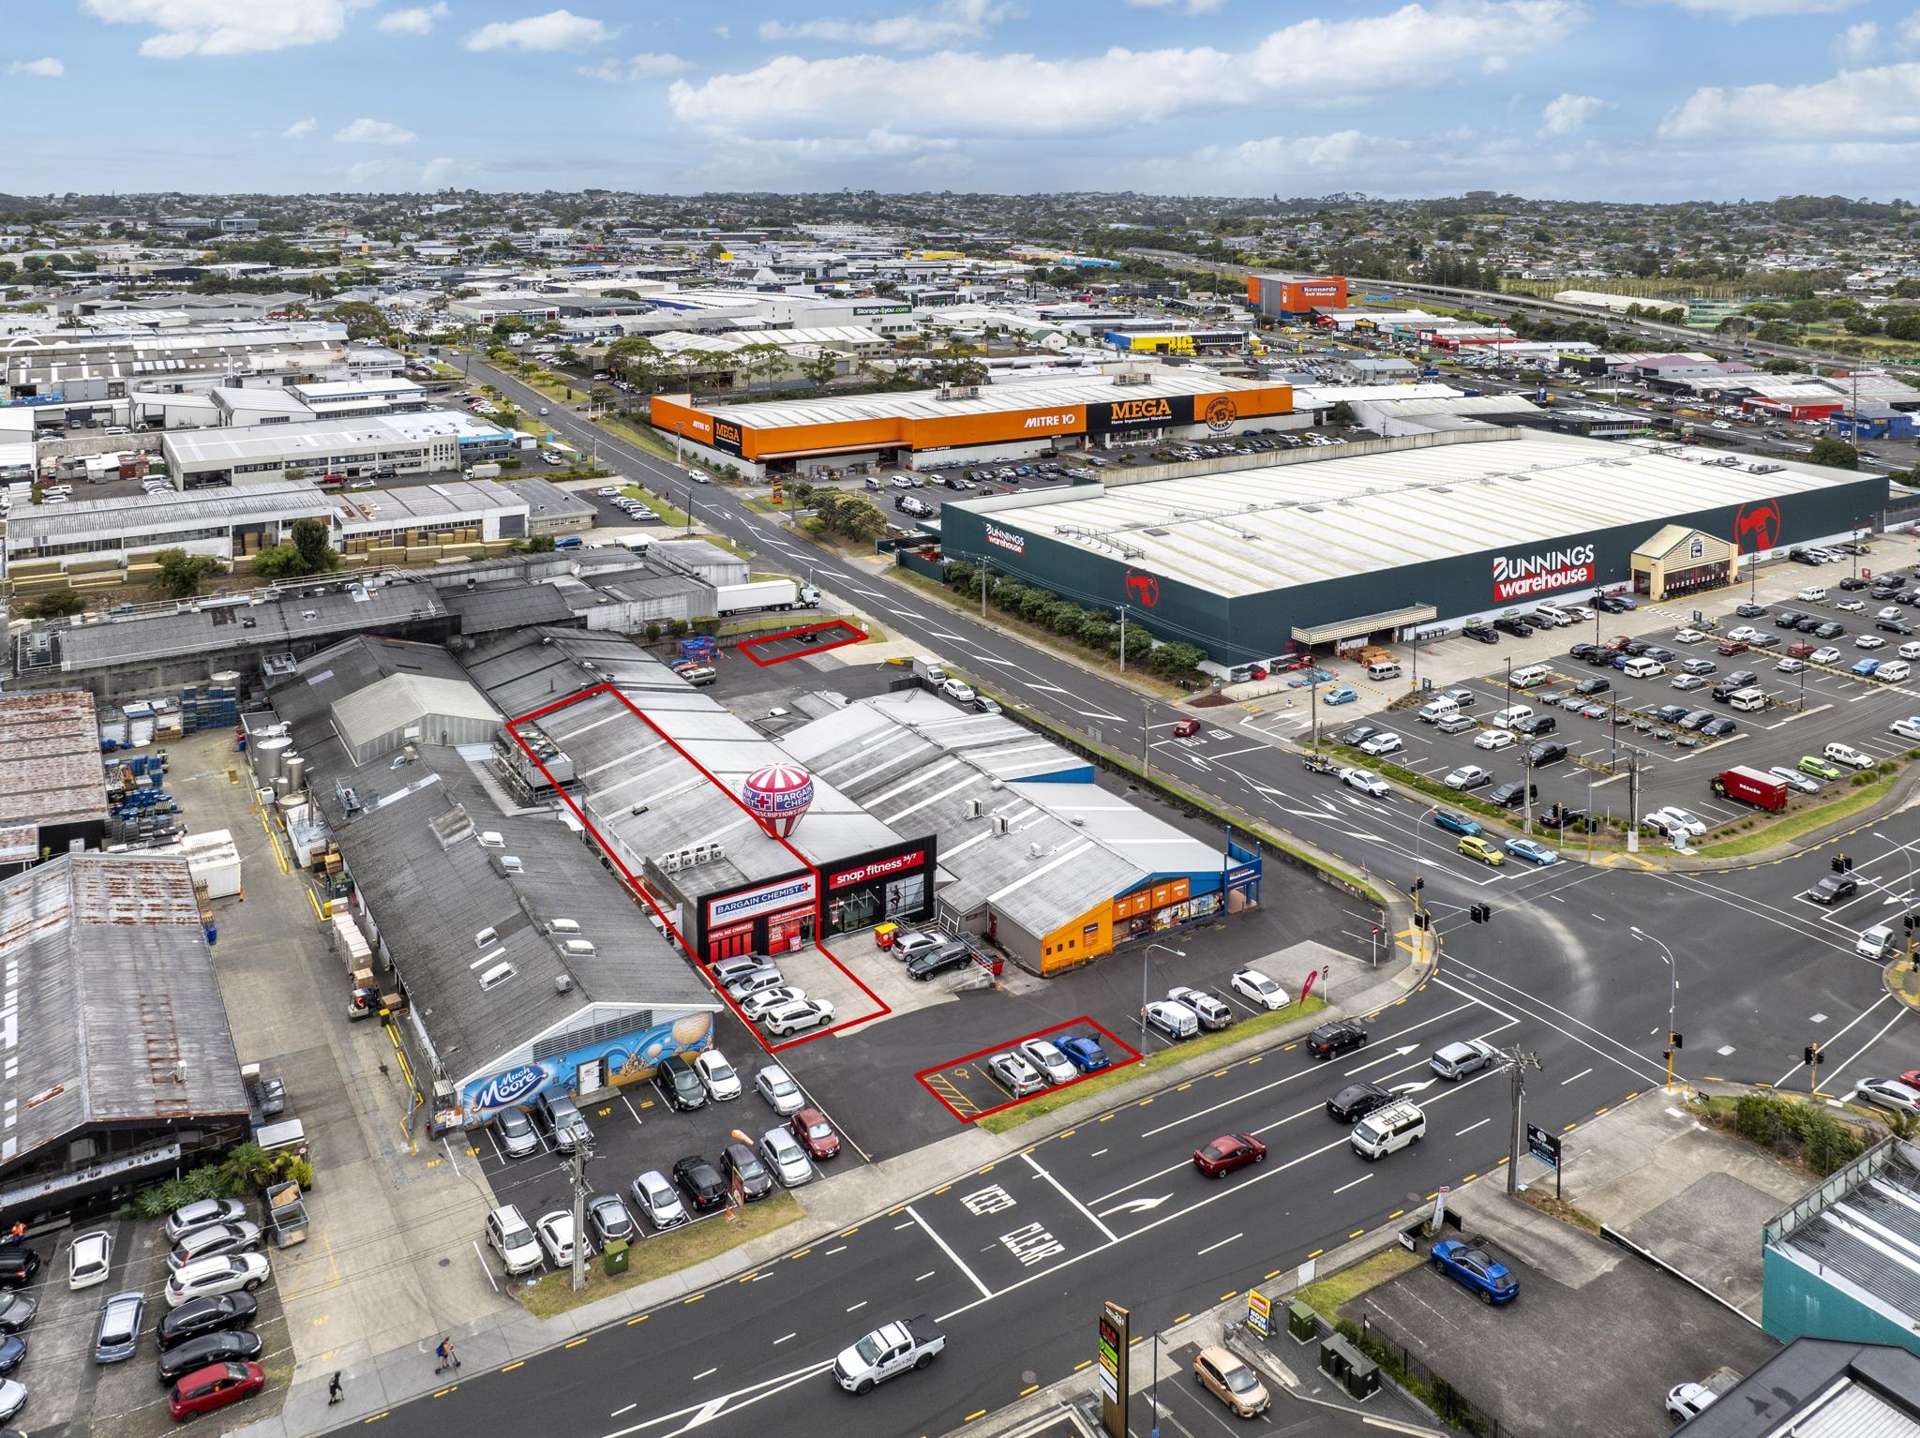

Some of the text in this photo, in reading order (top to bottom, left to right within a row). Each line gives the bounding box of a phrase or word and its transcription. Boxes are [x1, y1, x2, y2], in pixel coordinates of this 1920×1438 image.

[1024, 413, 1075, 428] MITRE 10
[1111, 399, 1172, 419] MEGA
[715, 422, 740, 442] MEGA
[985, 523, 1025, 546] BUNNINGS
[988, 535, 1022, 553] warehouse
[1492, 543, 1594, 582] BUNNINGS
[1499, 567, 1588, 598] warehouse
[776, 785, 812, 802] BARGAIN
[837, 853, 917, 884] snap fitness 24/7
[716, 897, 760, 914] BARGAIN
[761, 886, 799, 903] CHEMIST
[498, 1065, 531, 1087] Much
[473, 1071, 544, 1113] Moore
[960, 1184, 1017, 1216] KEEP
[999, 1221, 1066, 1267] CLEAR
